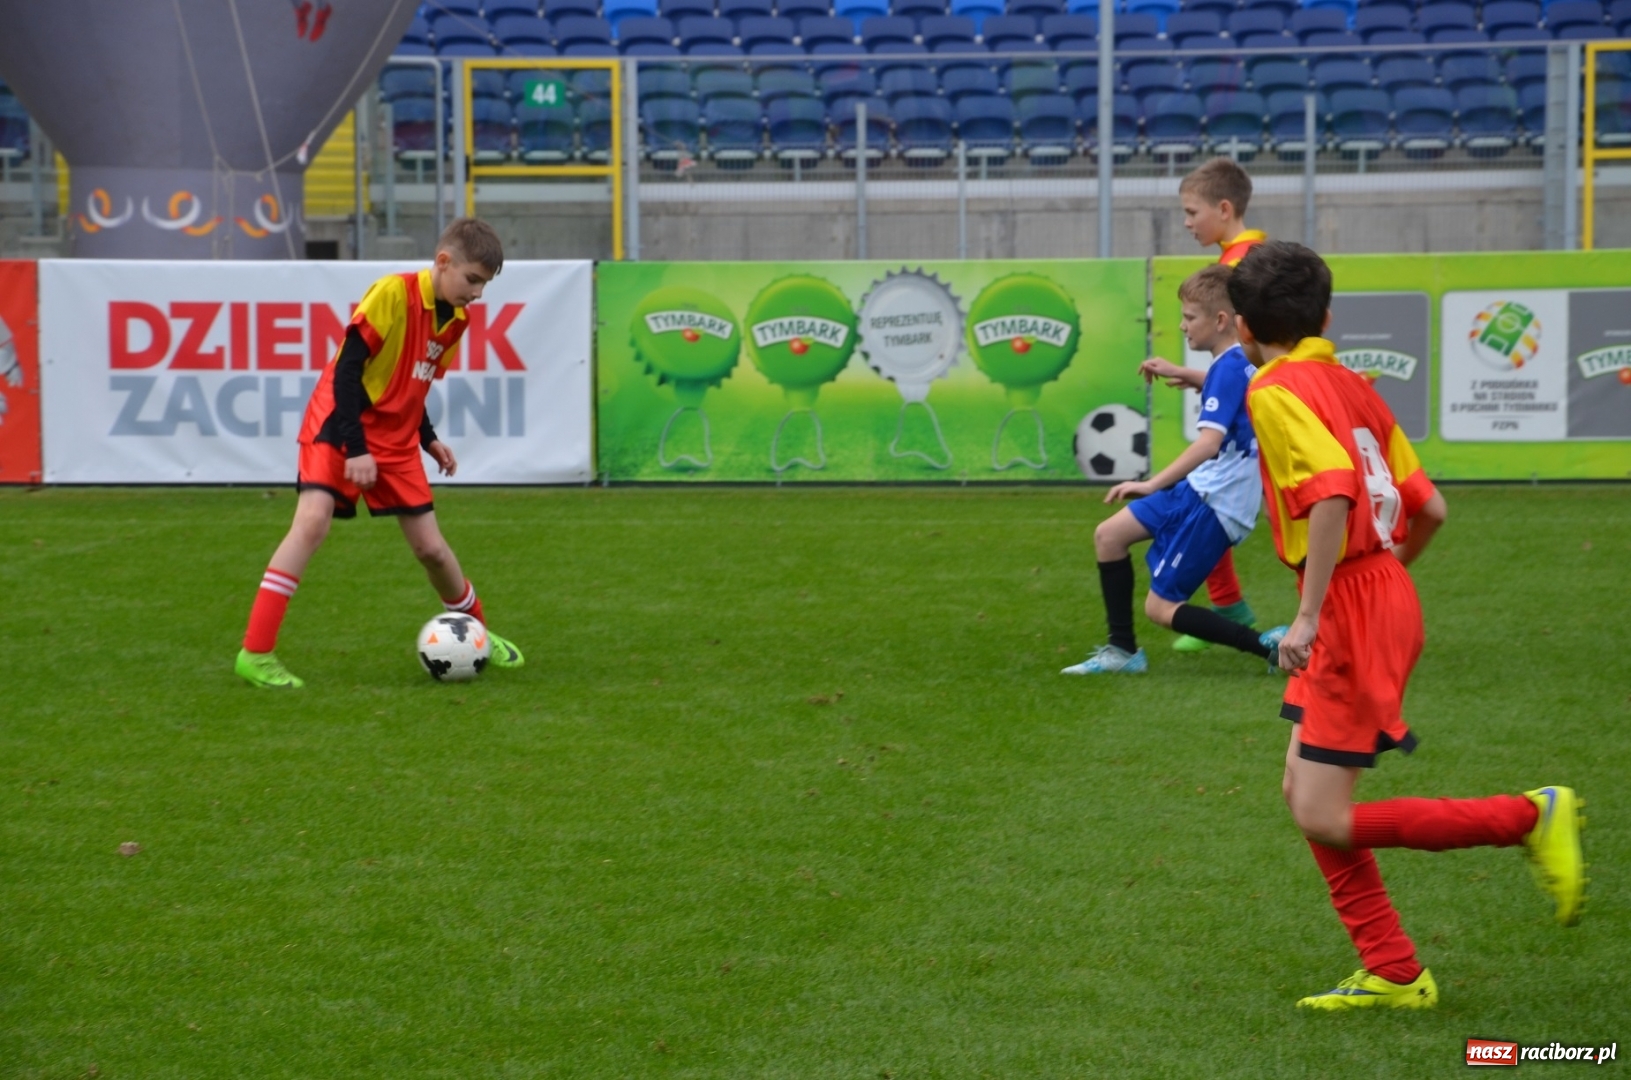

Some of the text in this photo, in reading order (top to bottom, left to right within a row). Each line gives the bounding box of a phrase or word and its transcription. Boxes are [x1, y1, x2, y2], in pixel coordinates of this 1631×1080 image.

[531, 83, 557, 105] 44
[108, 301, 527, 371] DZIENK
[650, 313, 729, 337] TYMBARK
[757, 320, 843, 343] TYMBARK
[978, 319, 1065, 342] TYMBARK
[884, 333, 932, 347] TYMBARK
[1341, 352, 1410, 375] MBARK
[108, 375, 525, 437] ZACHNI
